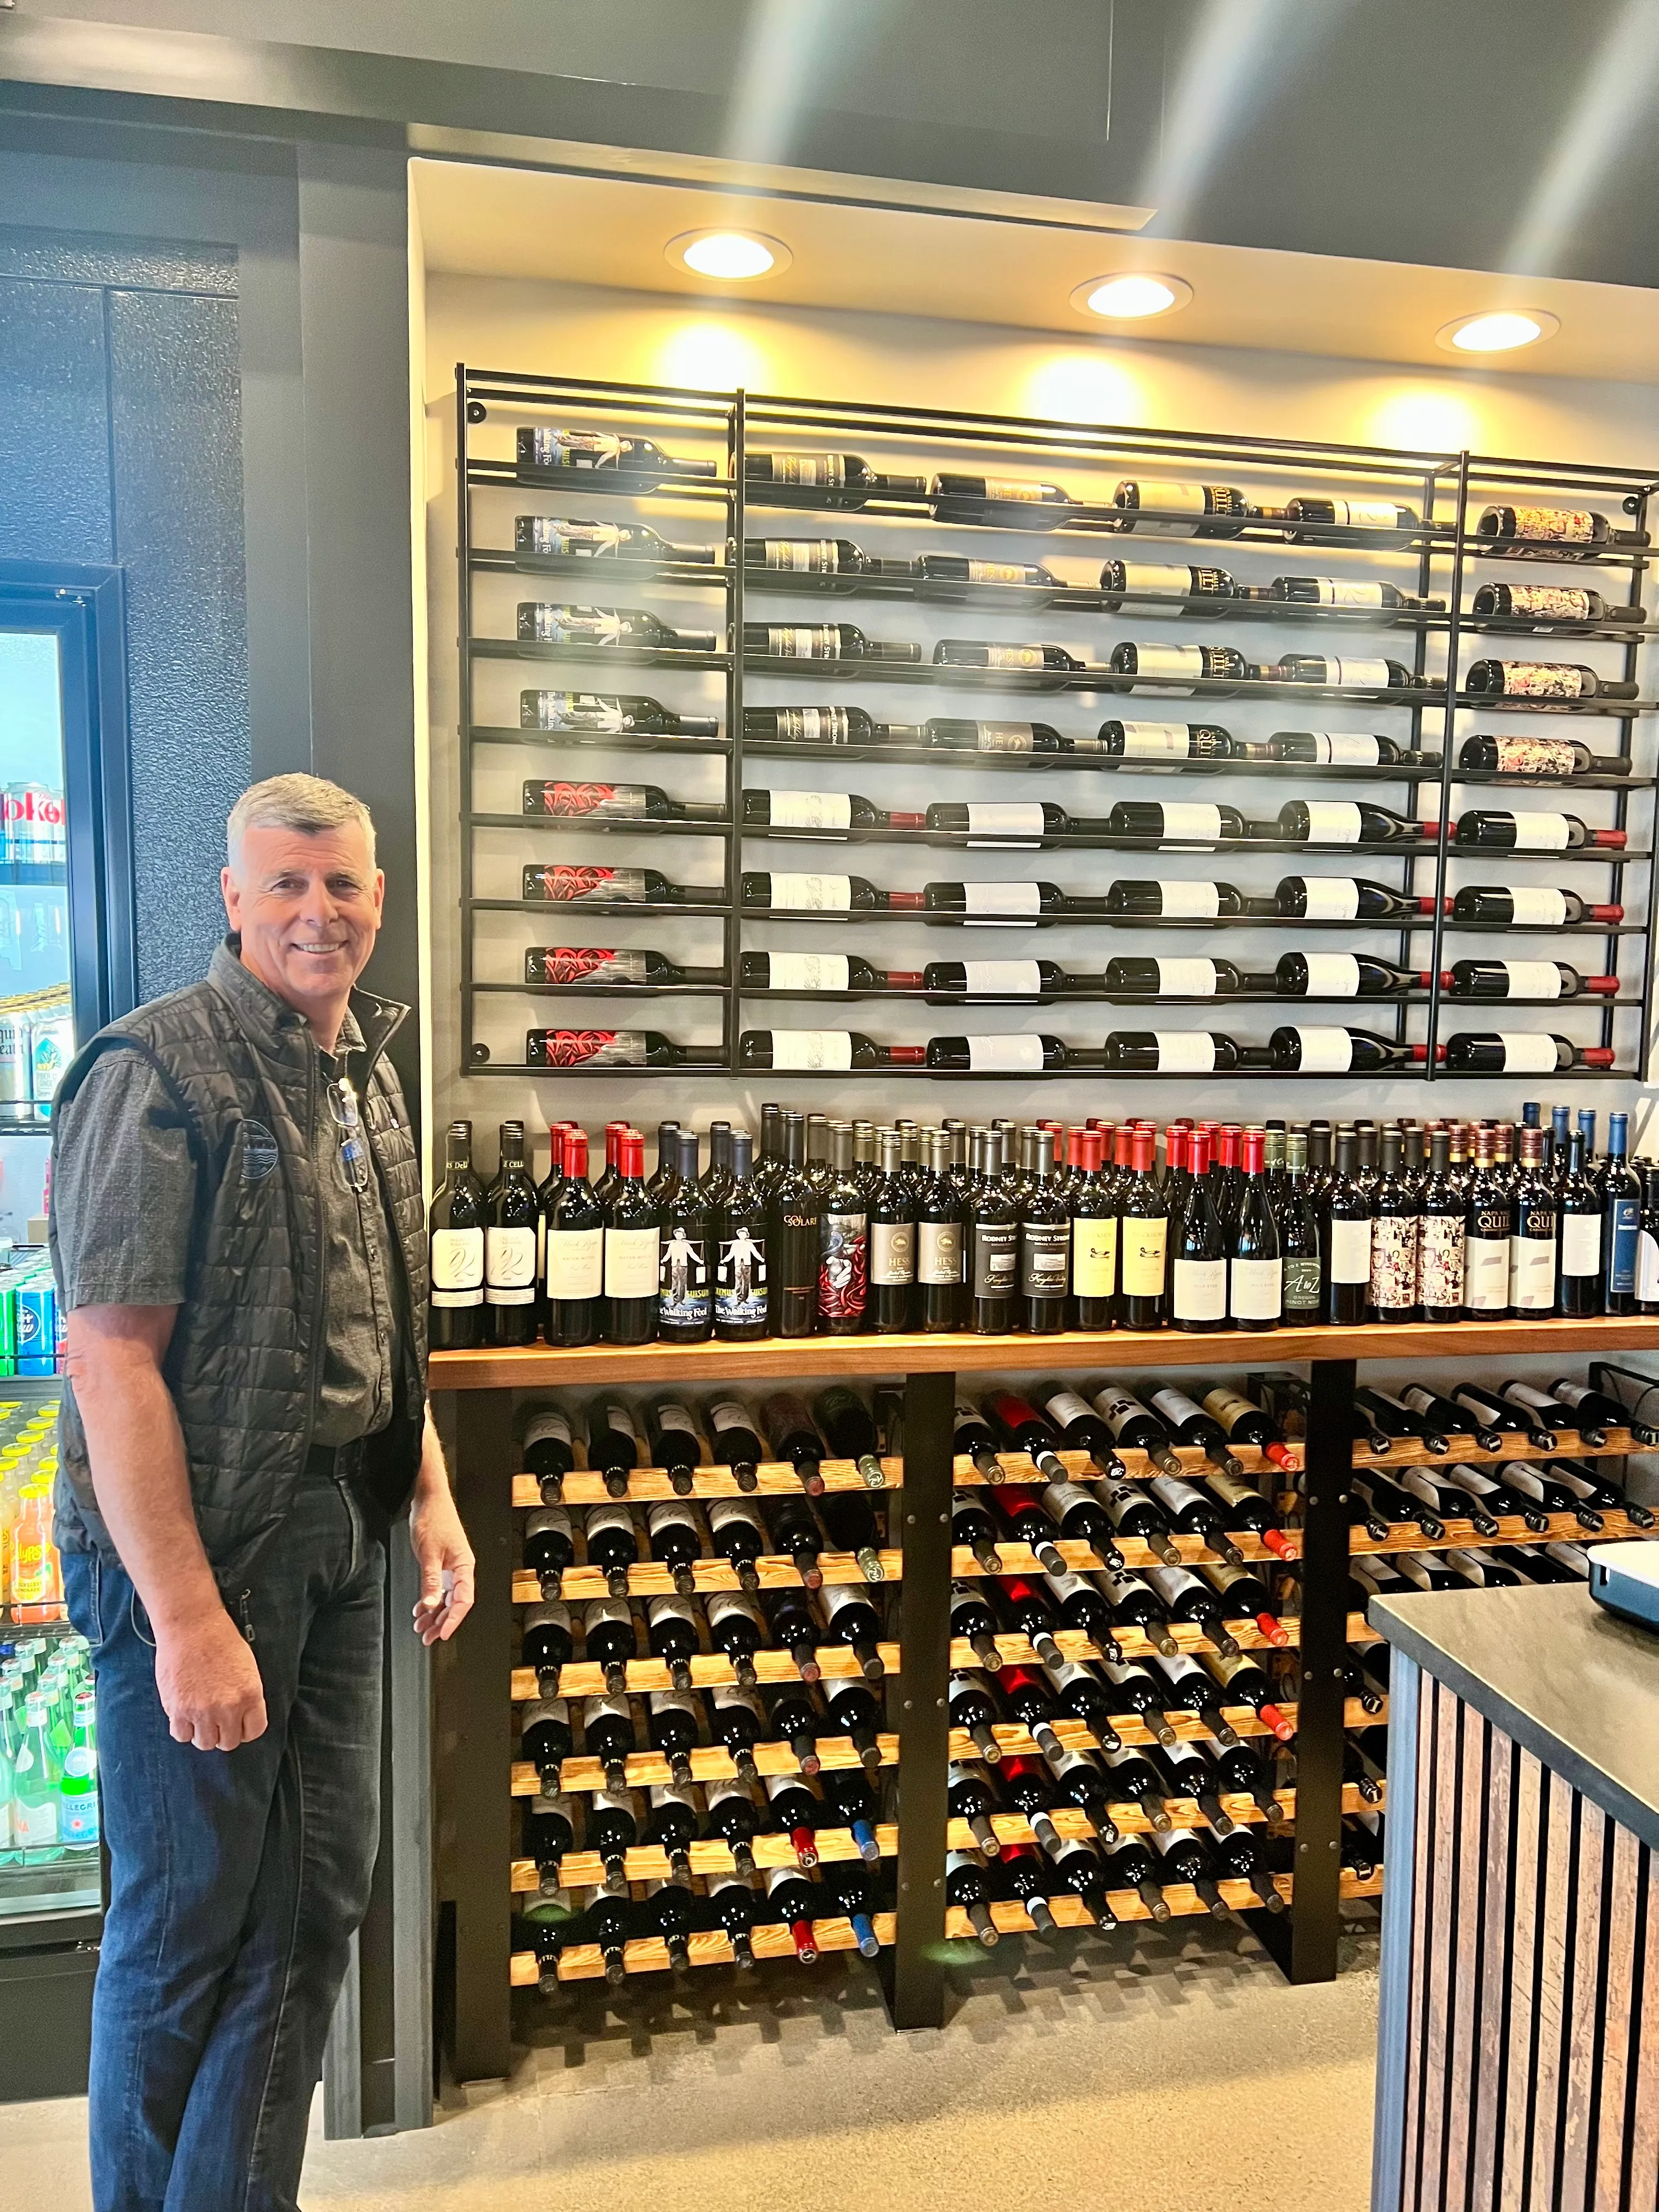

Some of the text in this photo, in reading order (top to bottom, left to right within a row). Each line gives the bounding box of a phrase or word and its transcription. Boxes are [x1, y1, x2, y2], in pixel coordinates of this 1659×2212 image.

[889, 1257, 910, 1266] HESS
[934, 1256, 957, 1266] HESS
[1284, 1274, 1304, 1293] A
[1308, 1277, 1320, 1294] Z
